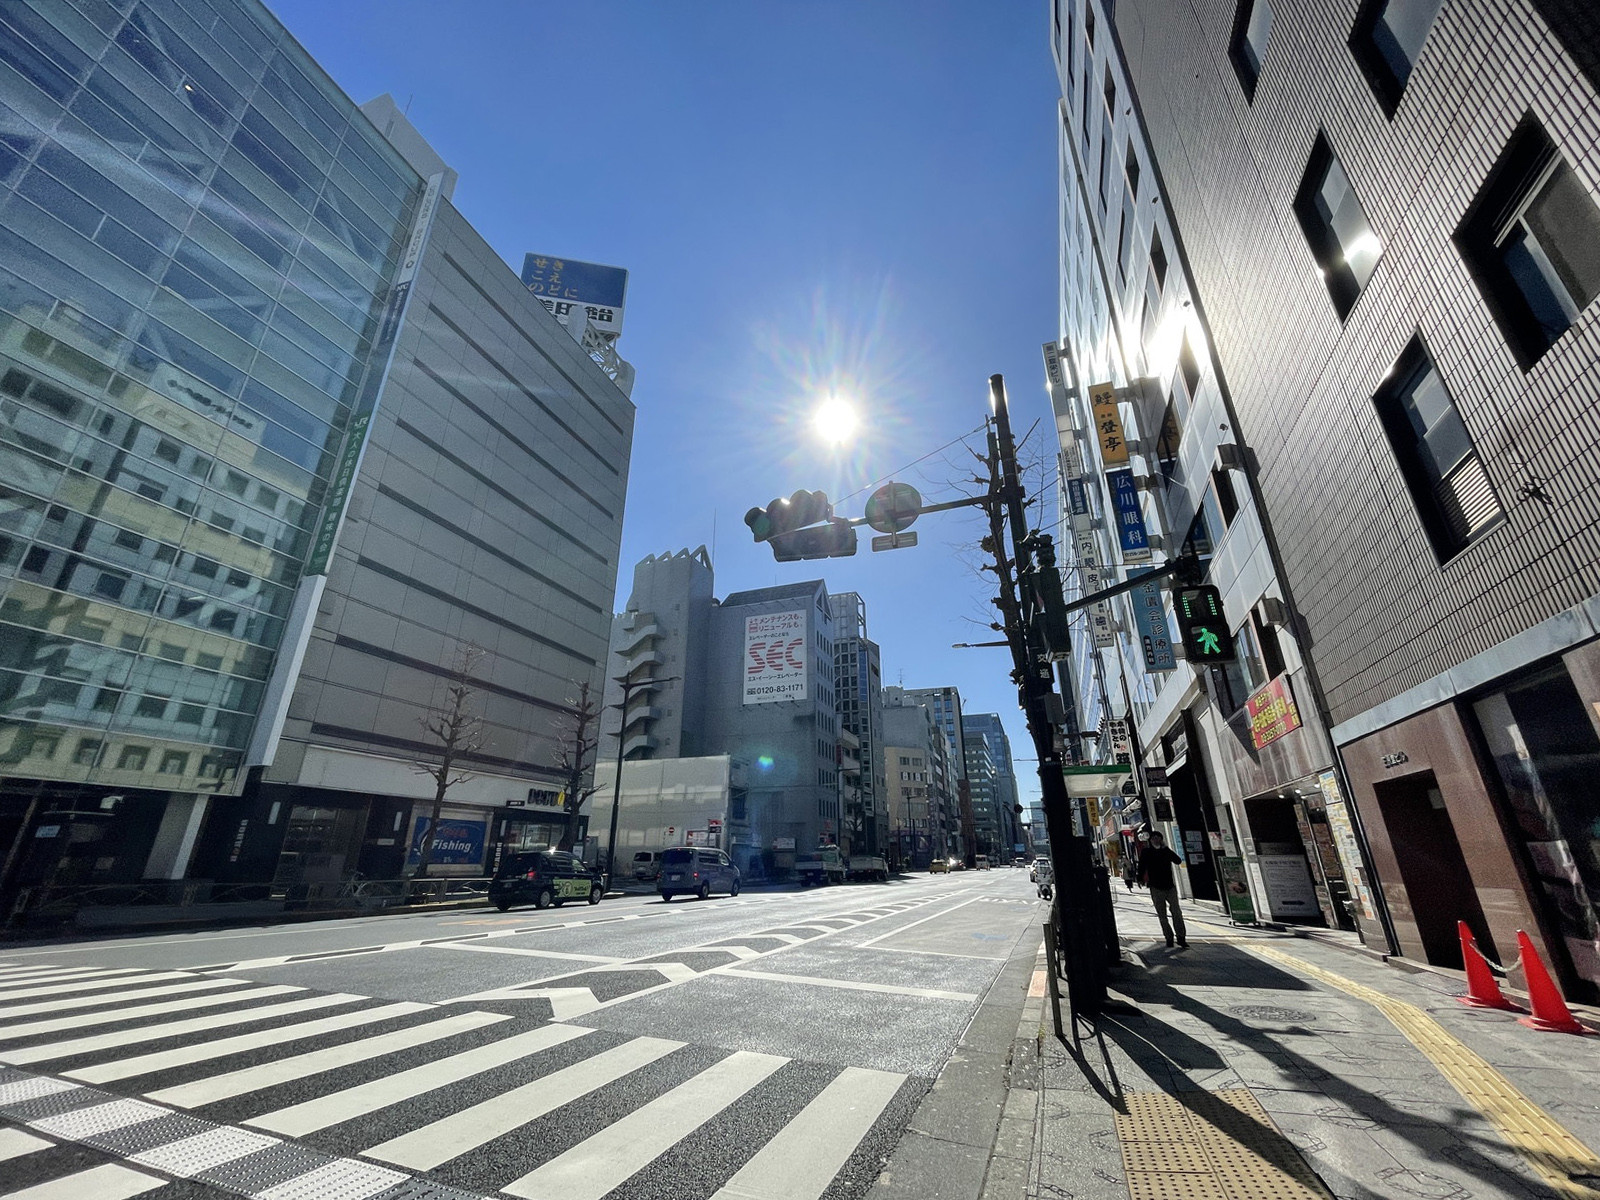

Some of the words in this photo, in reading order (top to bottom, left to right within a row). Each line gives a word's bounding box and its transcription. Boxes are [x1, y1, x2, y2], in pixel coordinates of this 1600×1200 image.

[533, 258, 565, 272] せき
[531, 270, 562, 283] こえ
[528, 282, 578, 298] のどに
[1116, 475, 1143, 545] 広川眼科
[748, 638, 803, 675] SEC
[756, 684, 804, 695] 0120-83-1171
[431, 839, 472, 853] Fishing
